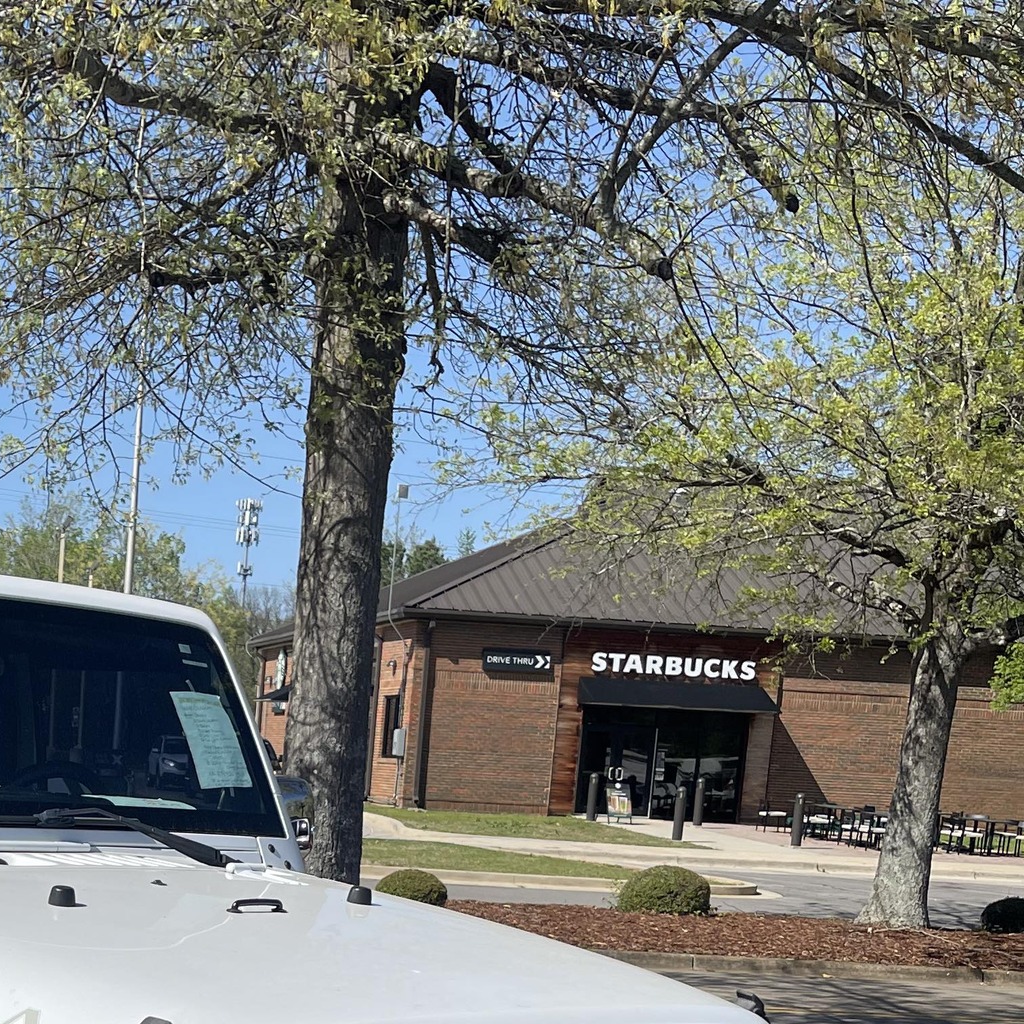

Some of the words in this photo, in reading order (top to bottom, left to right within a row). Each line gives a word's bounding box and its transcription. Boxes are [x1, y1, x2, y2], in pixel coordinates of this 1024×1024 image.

[486, 655, 511, 664] DRIVE
[512, 657, 534, 666] THRU
[591, 652, 757, 681] STARBUCKS
